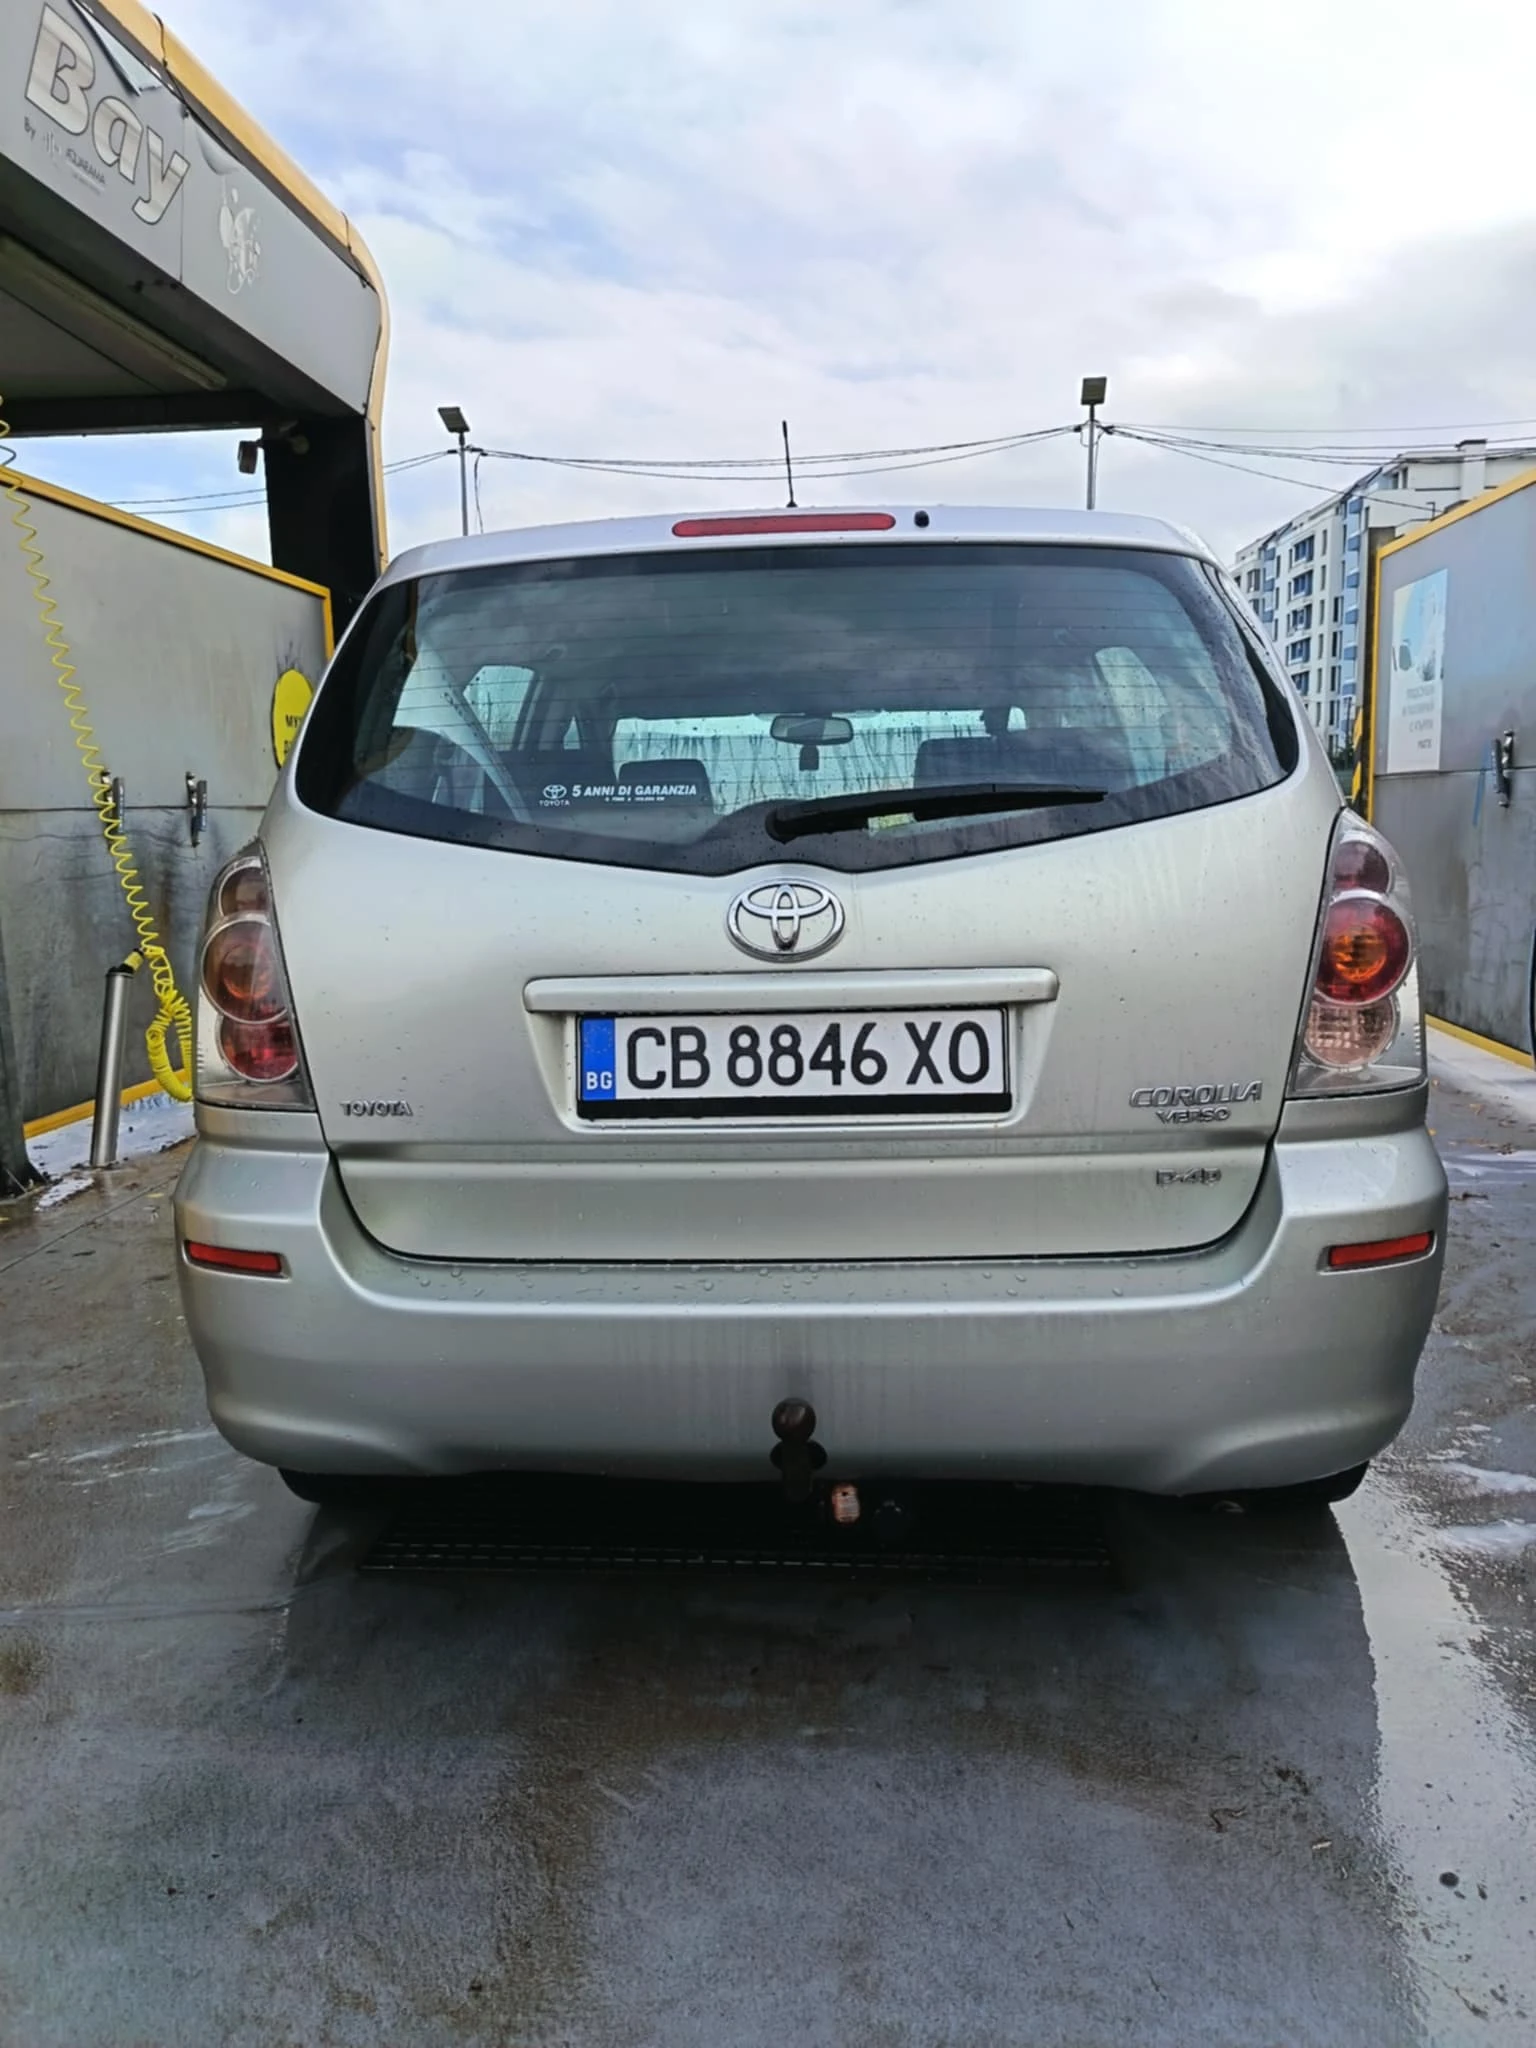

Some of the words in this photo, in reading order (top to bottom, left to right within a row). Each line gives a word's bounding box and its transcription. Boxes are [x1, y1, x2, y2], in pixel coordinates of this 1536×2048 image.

[24, 2, 191, 226] Bay
[571, 785, 582, 797] 5
[584, 785, 615, 796] ANNI
[617, 785, 632, 796] DI
[634, 784, 697, 796] GARANZIA
[539, 799, 570, 807] TOYOTA
[626, 1026, 711, 1090] CB
[726, 1022, 888, 1088] 8846
[904, 1020, 990, 1085] XO
[585, 1070, 613, 1091] BG
[1129, 1080, 1264, 1107] COROLLA
[340, 1100, 413, 1117] TOYOTA
[1156, 1106, 1232, 1124] VERSO
